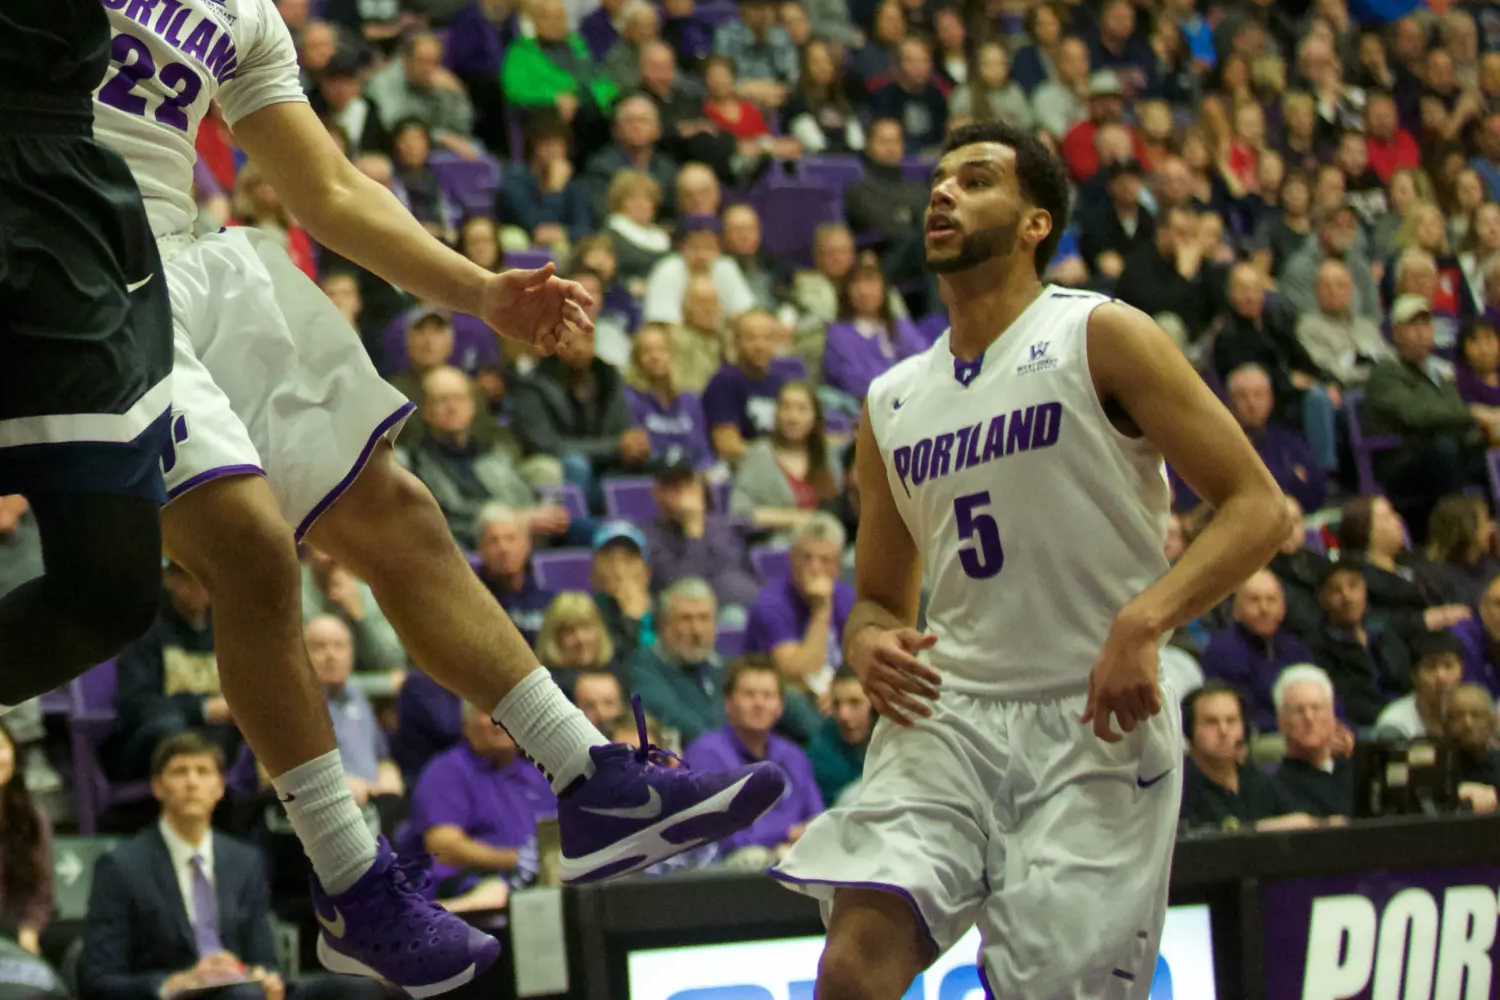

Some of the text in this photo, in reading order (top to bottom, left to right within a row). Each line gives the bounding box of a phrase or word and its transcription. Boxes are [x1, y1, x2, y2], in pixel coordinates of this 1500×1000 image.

[98, 33, 202, 132] 22
[893, 401, 1062, 499] PORTLAND
[953, 490, 1004, 579] 5
[1301, 884, 1500, 1000] POR
